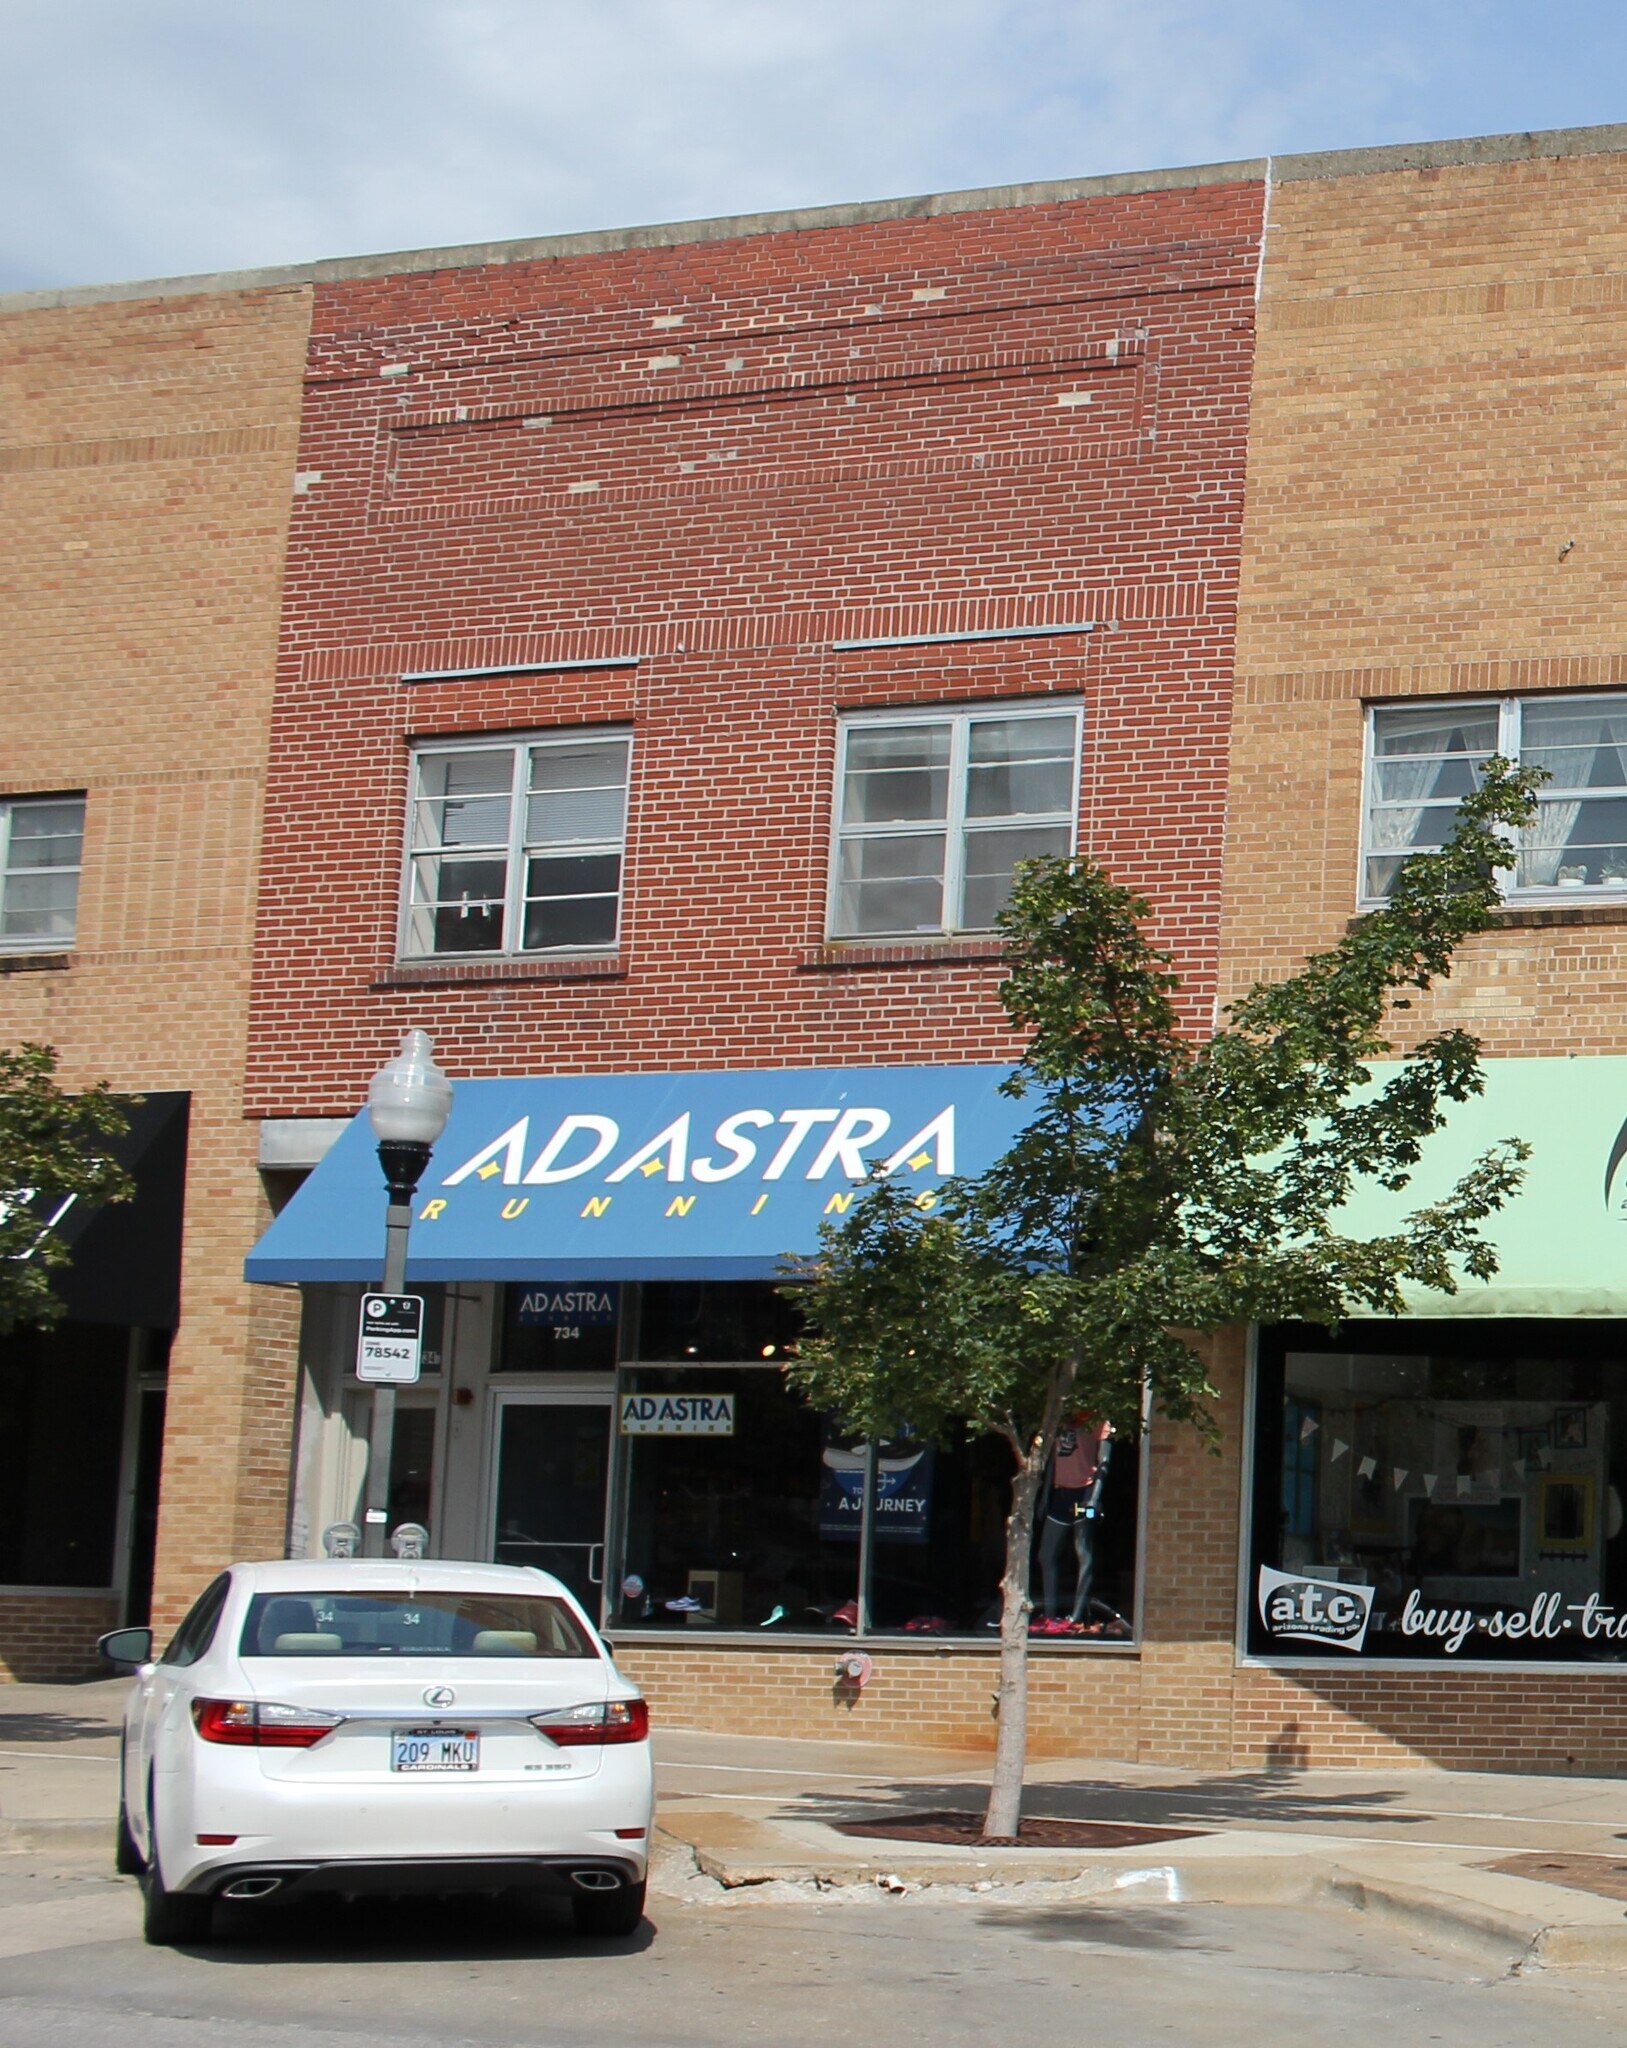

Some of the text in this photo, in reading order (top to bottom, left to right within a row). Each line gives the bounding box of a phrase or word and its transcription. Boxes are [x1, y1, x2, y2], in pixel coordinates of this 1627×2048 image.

[553, 1327, 580, 1339] 734
[365, 1347, 410, 1359] 78542
[851, 1498, 926, 1512] JURNEY
[398, 1742, 474, 1763] 209 MKU
